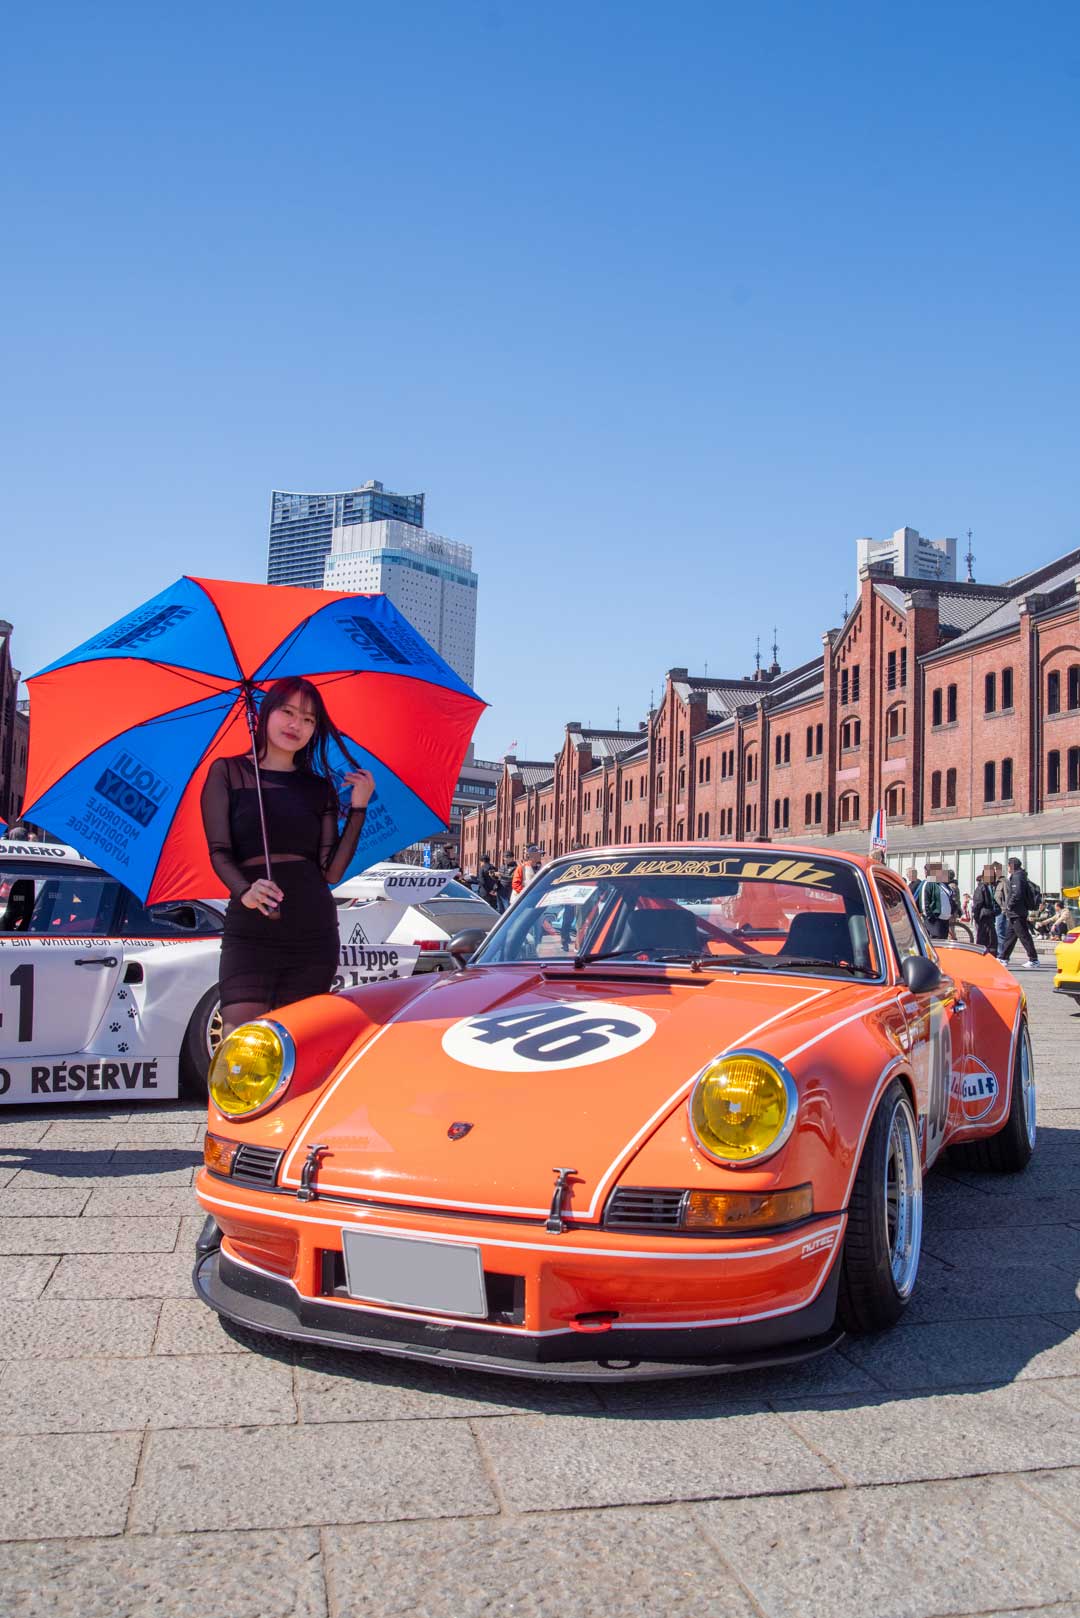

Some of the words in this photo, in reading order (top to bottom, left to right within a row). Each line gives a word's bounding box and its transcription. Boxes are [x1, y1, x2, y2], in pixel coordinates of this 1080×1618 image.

[387, 877, 446, 887] DUNLOP
[557, 862, 628, 881] BODY
[631, 859, 740, 876] WORKS
[40, 939, 111, 948] Whittington
[121, 939, 155, 947] Klaus
[338, 945, 399, 971] ilippe
[0, 964, 34, 1042] 1
[467, 1006, 641, 1061] 46
[31, 1058, 158, 1094] RÉSERVÉ
[962, 1077, 995, 1098] Gulf
